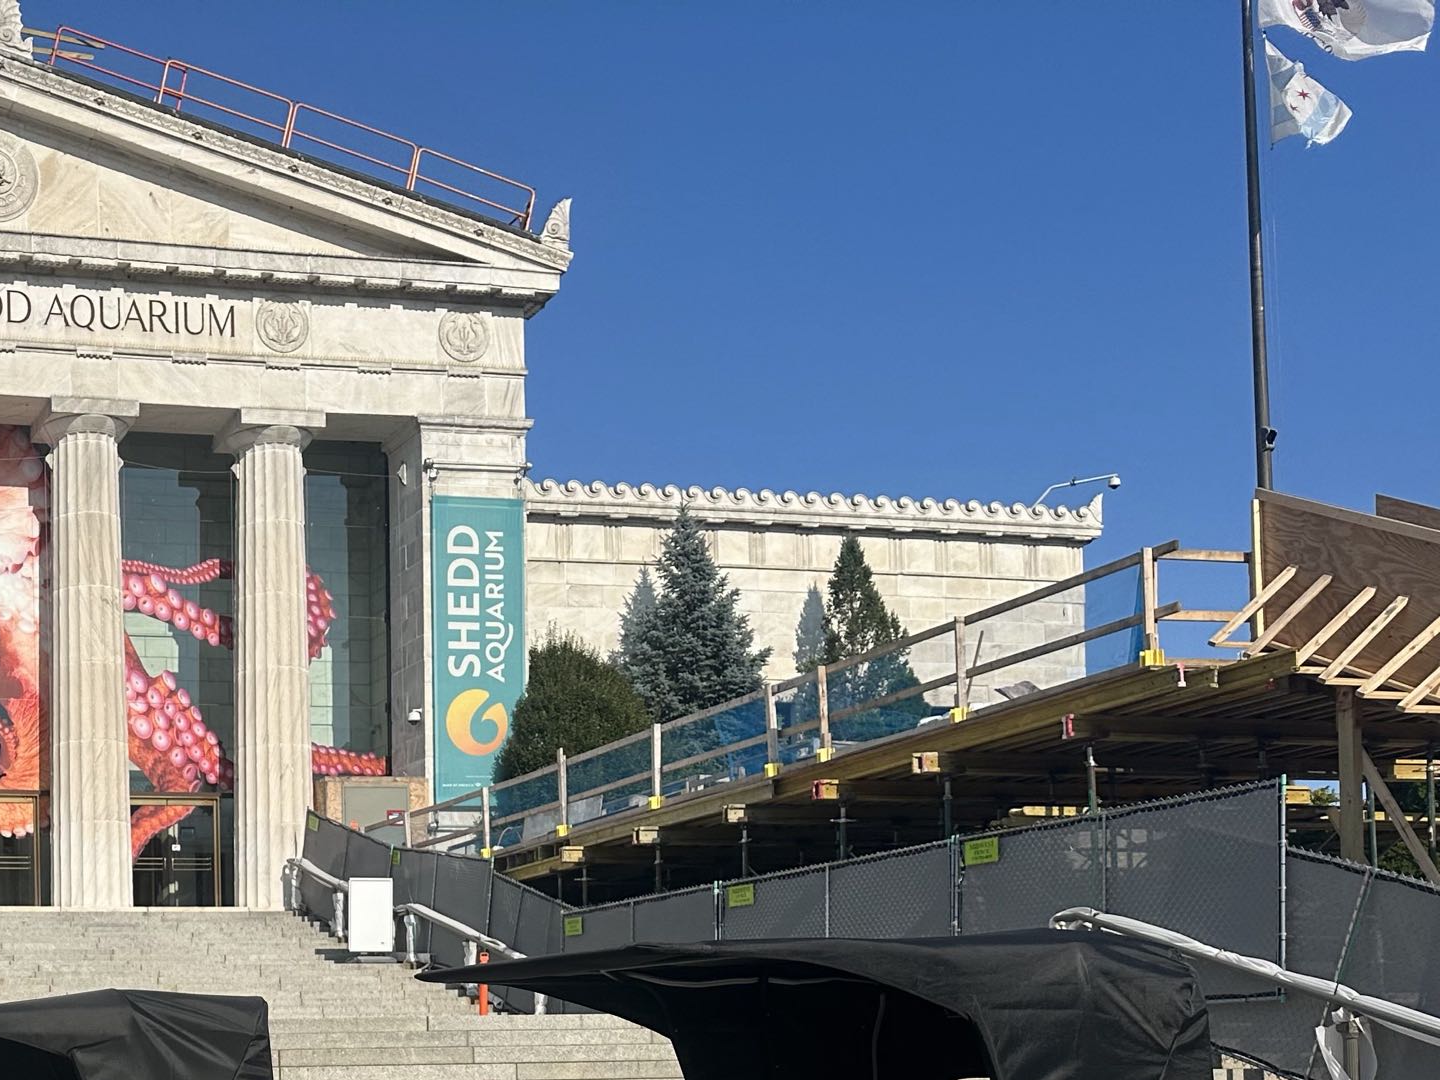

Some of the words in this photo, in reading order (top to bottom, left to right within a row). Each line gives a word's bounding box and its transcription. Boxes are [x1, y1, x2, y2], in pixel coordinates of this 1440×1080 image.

[44, 294, 236, 338] AQUARIUM
[447, 525, 481, 677] SHEDD
[484, 531, 514, 683] AQUARIUM
